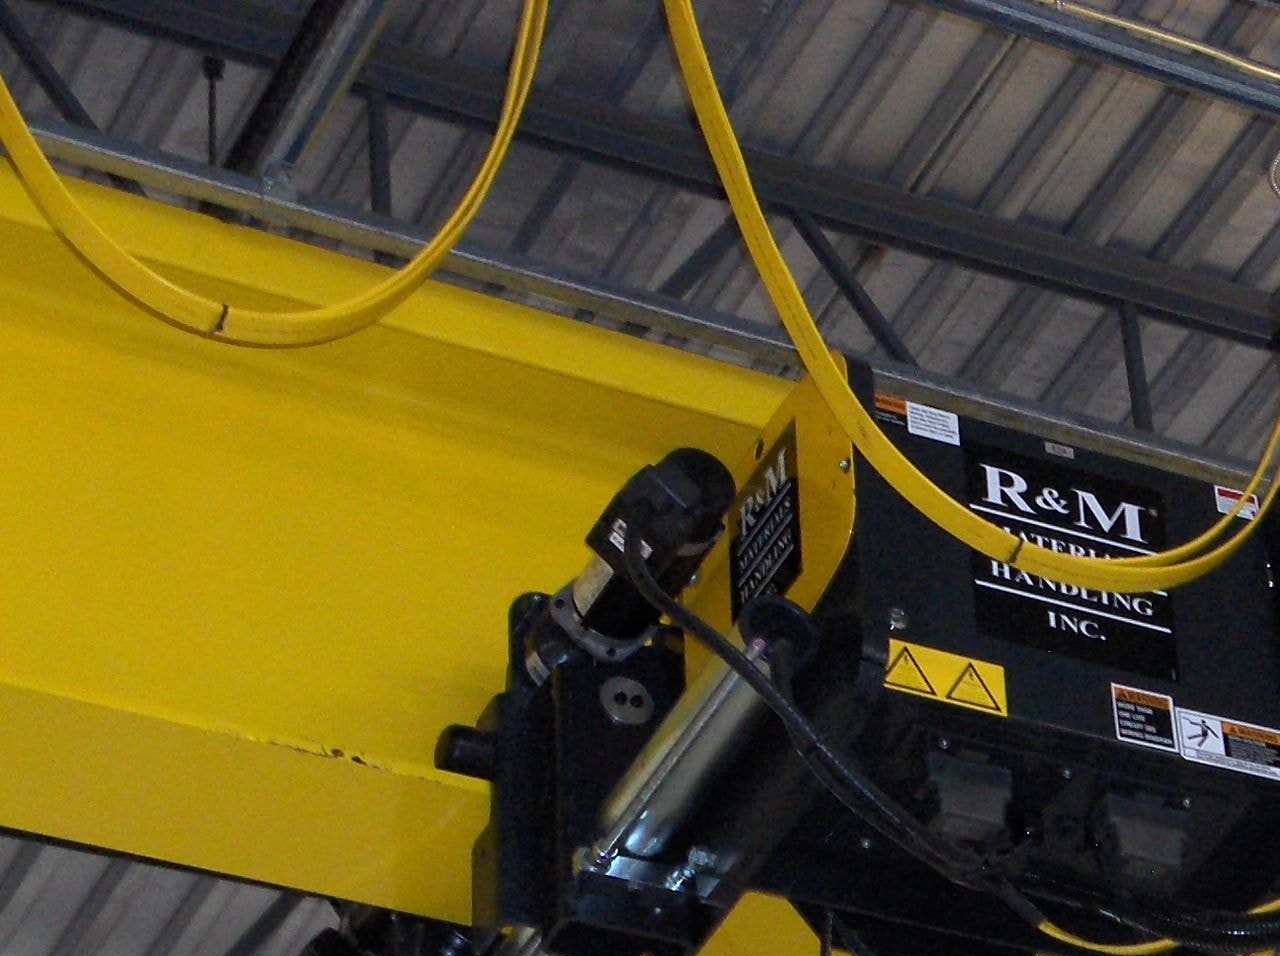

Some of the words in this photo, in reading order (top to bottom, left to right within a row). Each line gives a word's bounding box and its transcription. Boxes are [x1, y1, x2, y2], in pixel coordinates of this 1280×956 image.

[741, 447, 787, 538] R&M
[979, 463, 1148, 545] R&M
[990, 560, 1154, 616] HANDLING
[1048, 610, 1107, 641] INC.
